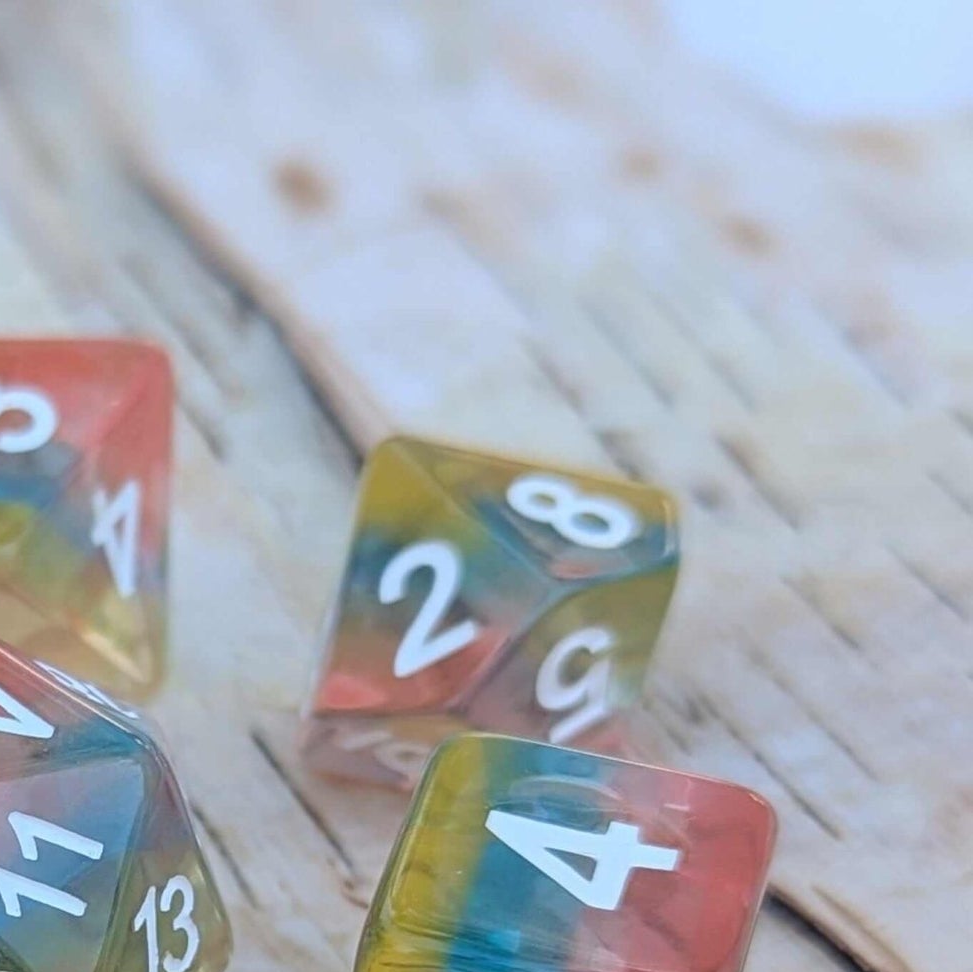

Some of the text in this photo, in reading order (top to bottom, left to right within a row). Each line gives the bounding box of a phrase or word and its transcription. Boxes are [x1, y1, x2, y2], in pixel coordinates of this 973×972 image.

[91, 479, 140, 597] 4
[506, 474, 637, 549] 8
[378, 539, 480, 679] 2
[484, 808, 681, 910] 4
